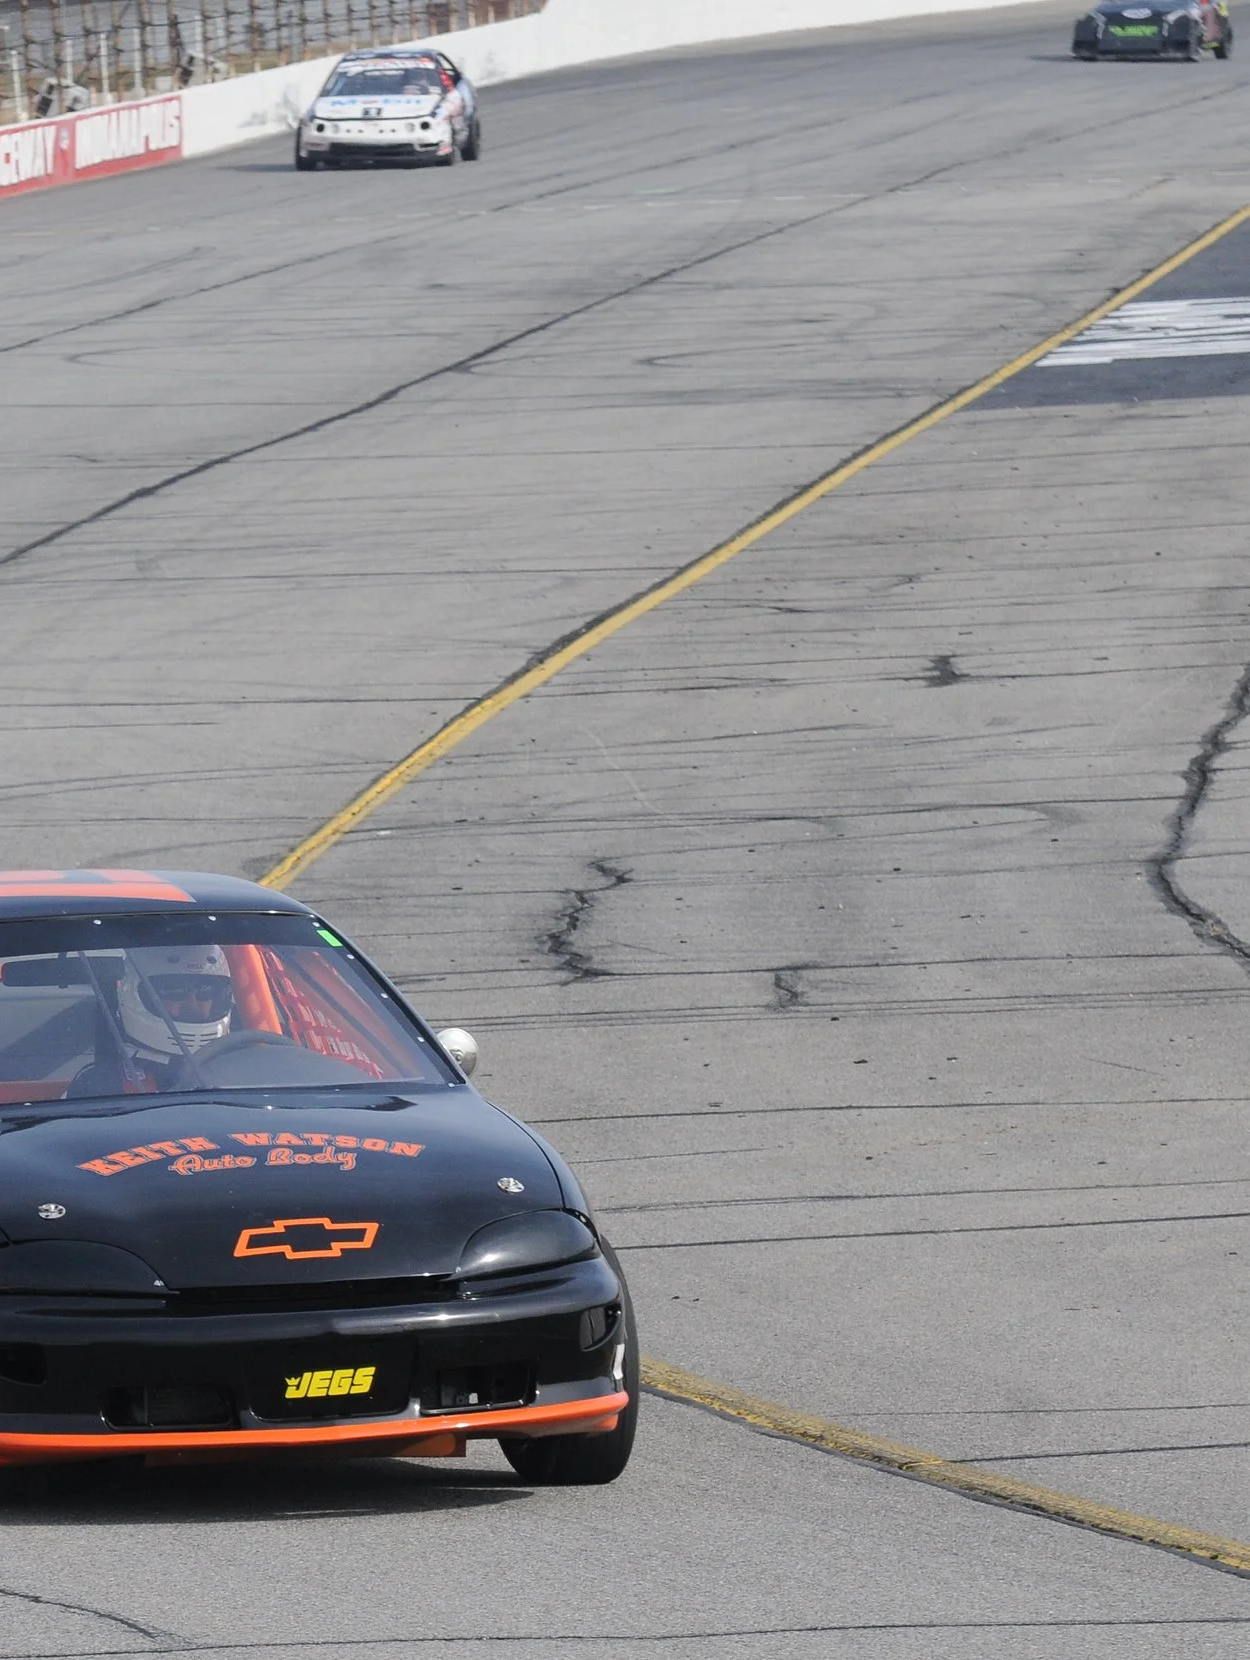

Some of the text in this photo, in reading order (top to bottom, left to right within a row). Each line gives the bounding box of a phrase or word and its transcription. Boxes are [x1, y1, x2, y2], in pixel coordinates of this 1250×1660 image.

[75, 99, 180, 170] INDIANAPOLIS
[75, 1132, 426, 1176] KEITH WATSON
[167, 1146, 357, 1175] Auto Body
[285, 1366, 376, 1399] JEGS
